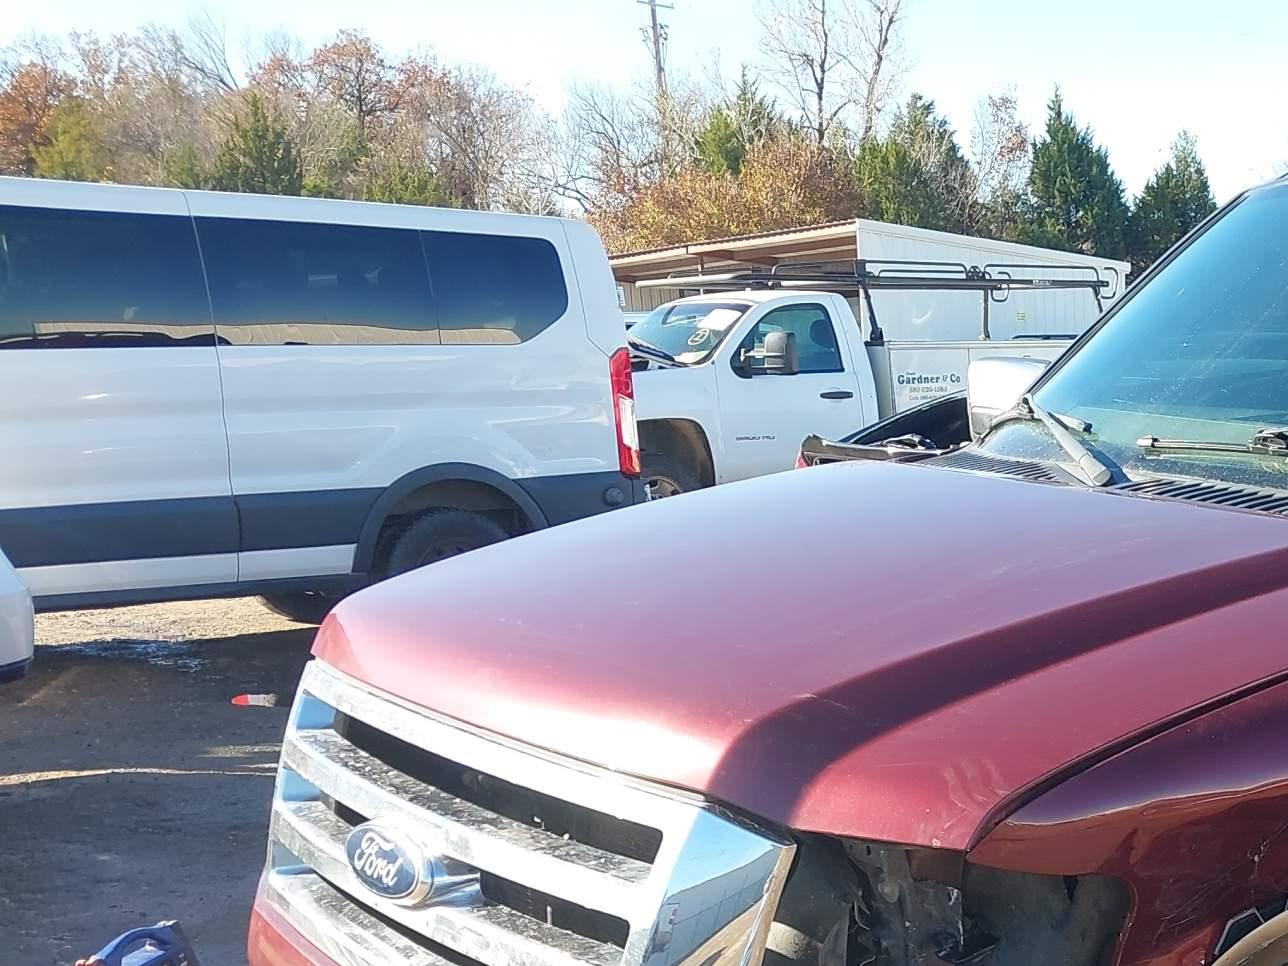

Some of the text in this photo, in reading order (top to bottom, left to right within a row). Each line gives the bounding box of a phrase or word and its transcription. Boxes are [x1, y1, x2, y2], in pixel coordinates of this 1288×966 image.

[897, 374, 940, 385] Gardner
[950, 373, 961, 384] Co
[353, 830, 404, 887] Ford
